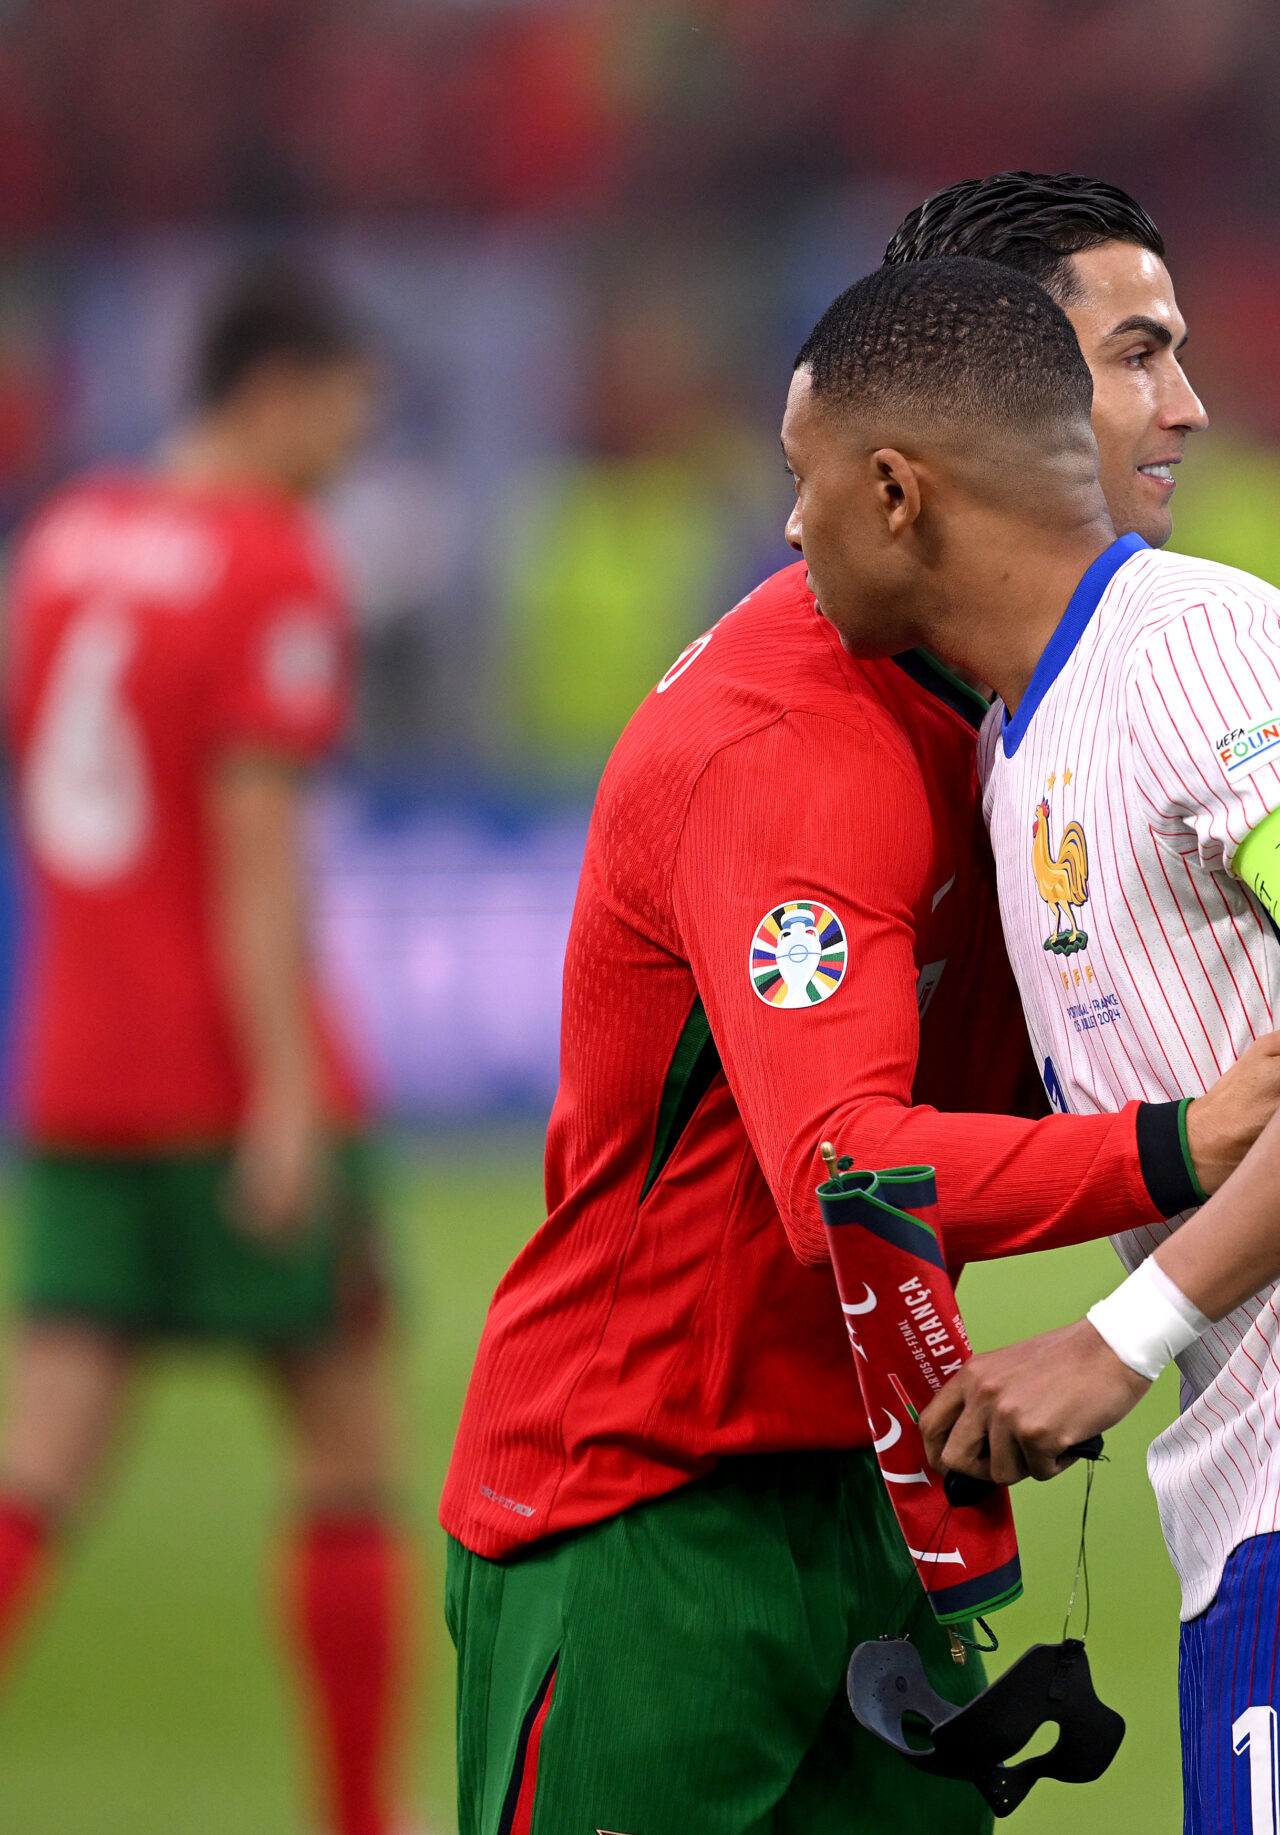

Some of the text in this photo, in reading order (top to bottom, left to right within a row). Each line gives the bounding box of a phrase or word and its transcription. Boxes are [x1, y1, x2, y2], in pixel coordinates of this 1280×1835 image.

[1216, 728, 1245, 750] UEFA
[1092, 994, 1119, 1012] FRANCE
[1097, 1008, 1121, 1026] 2024
[898, 1276, 955, 1358] FRANÇA
